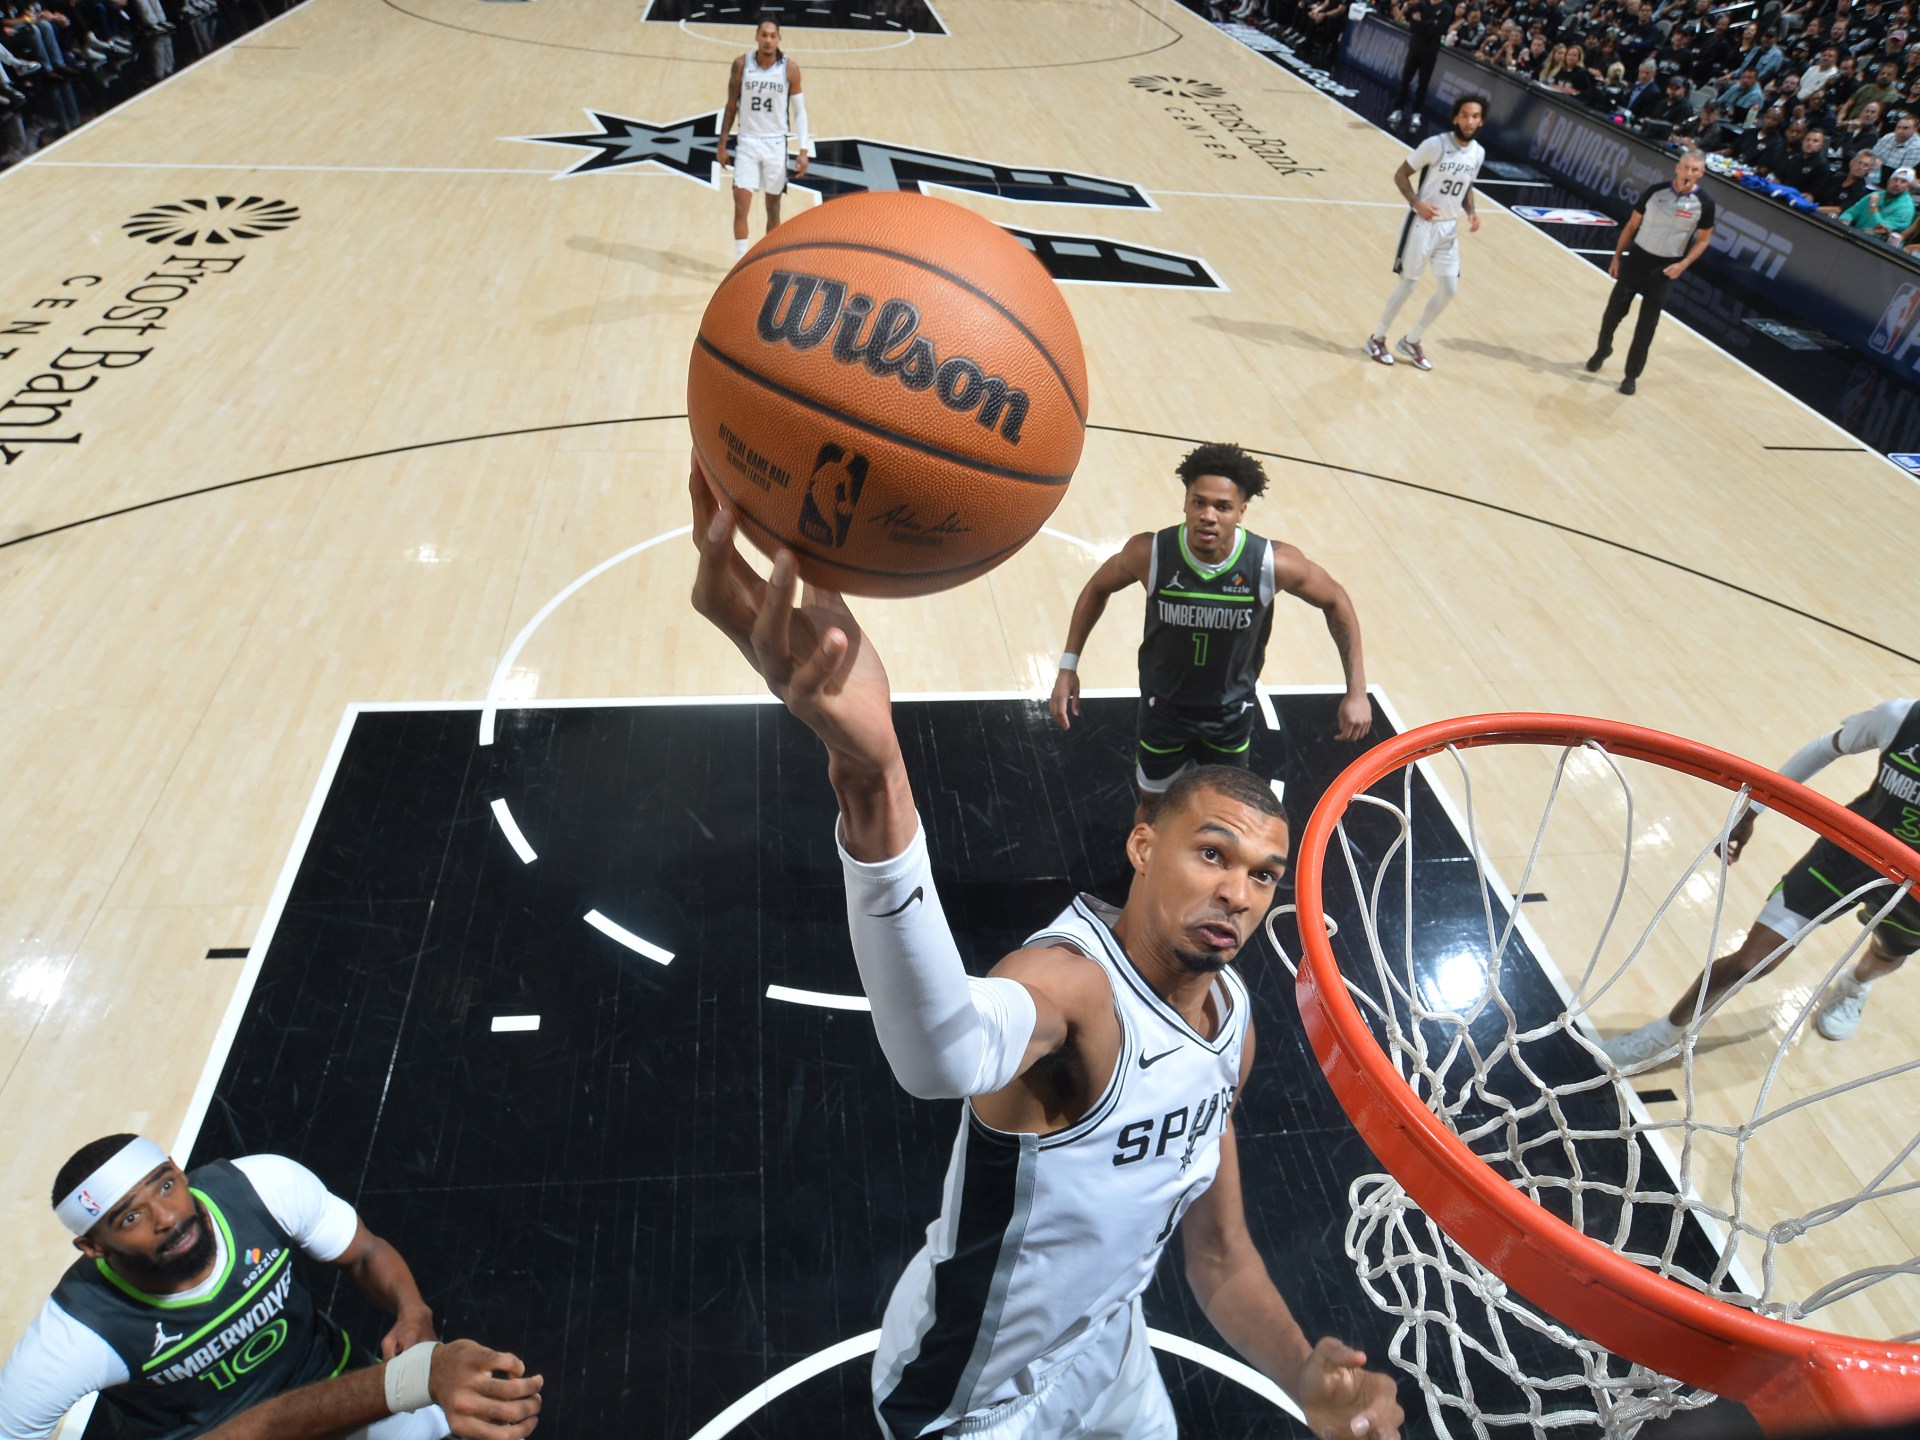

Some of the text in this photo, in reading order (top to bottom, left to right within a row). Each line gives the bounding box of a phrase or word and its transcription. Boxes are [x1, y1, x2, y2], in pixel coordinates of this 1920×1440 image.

[745, 81, 784, 93] SPURS
[751, 97, 773, 112] 24
[1164, 106, 1238, 160] CENTER
[1194, 101, 1327, 177] Frost Bank
[1540, 115, 1630, 197] PLAYOFFS
[1440, 180, 1463, 196] 30
[83, 255, 246, 336] Frost
[756, 269, 1030, 446] Wilson
[1222, 585, 1250, 594] sezzle
[1158, 600, 1252, 631] TIMBERWOLVES
[1192, 632, 1208, 666] 1
[242, 1248, 280, 1289] sezzle
[147, 1261, 293, 1385] TIMBERWOLVE
[199, 1318, 288, 1390] 10
